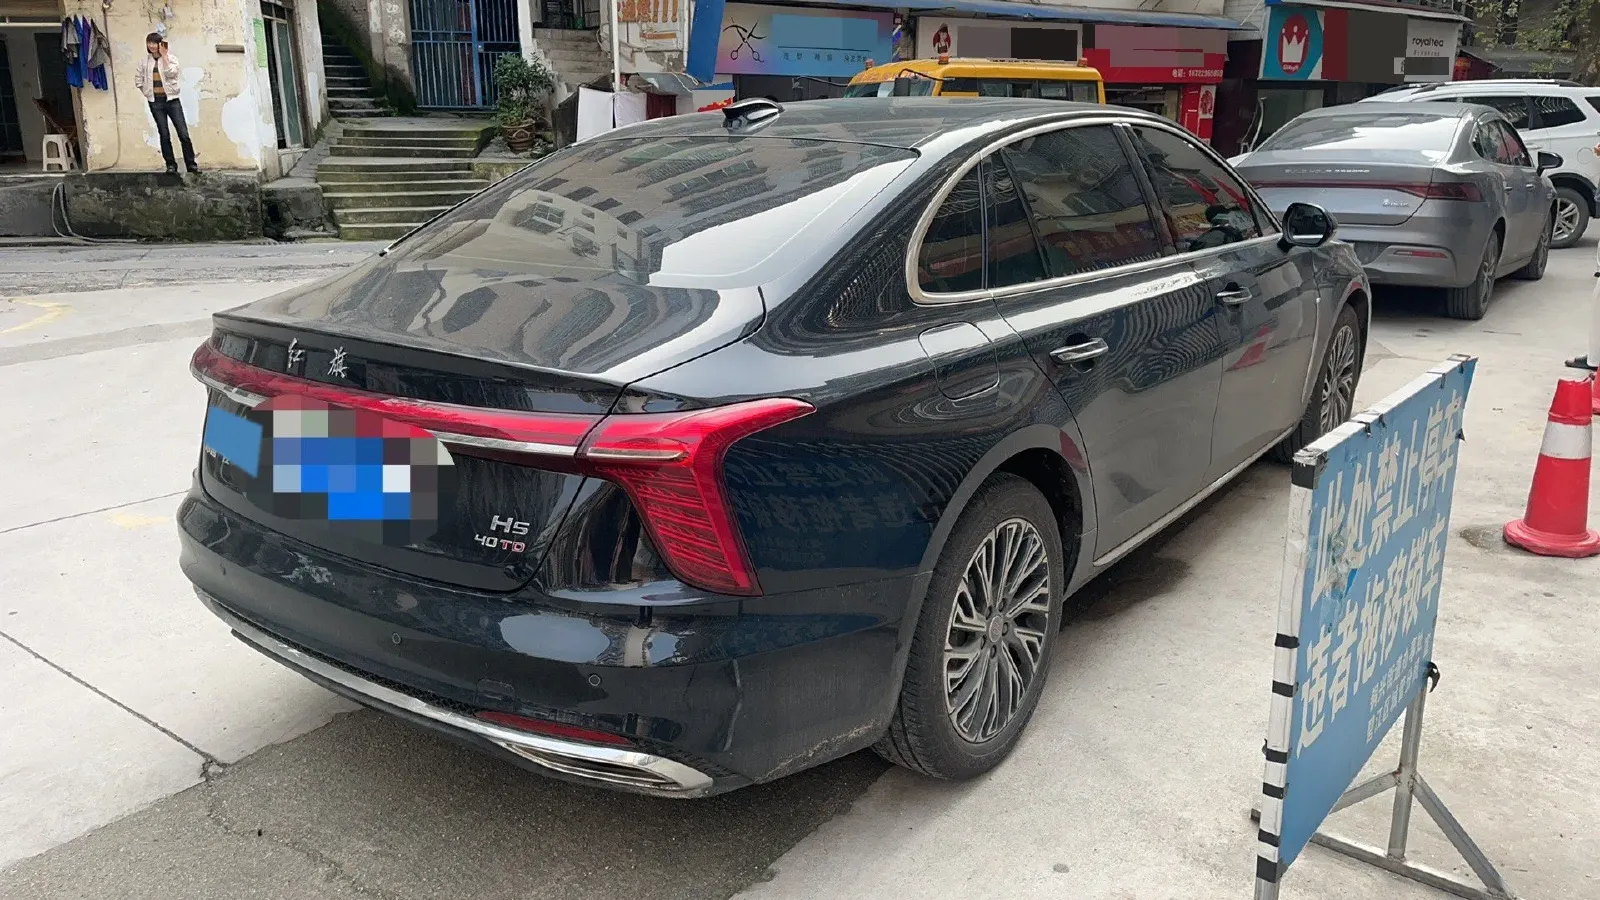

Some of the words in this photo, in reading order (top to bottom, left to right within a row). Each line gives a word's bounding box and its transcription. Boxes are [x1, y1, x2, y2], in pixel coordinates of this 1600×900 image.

[1412, 37, 1444, 47] royaltea
[288, 337, 349, 378] 红旗
[1310, 388, 1462, 611] 此处禁止停车
[1296, 513, 1446, 760] 违者拖移锁车
